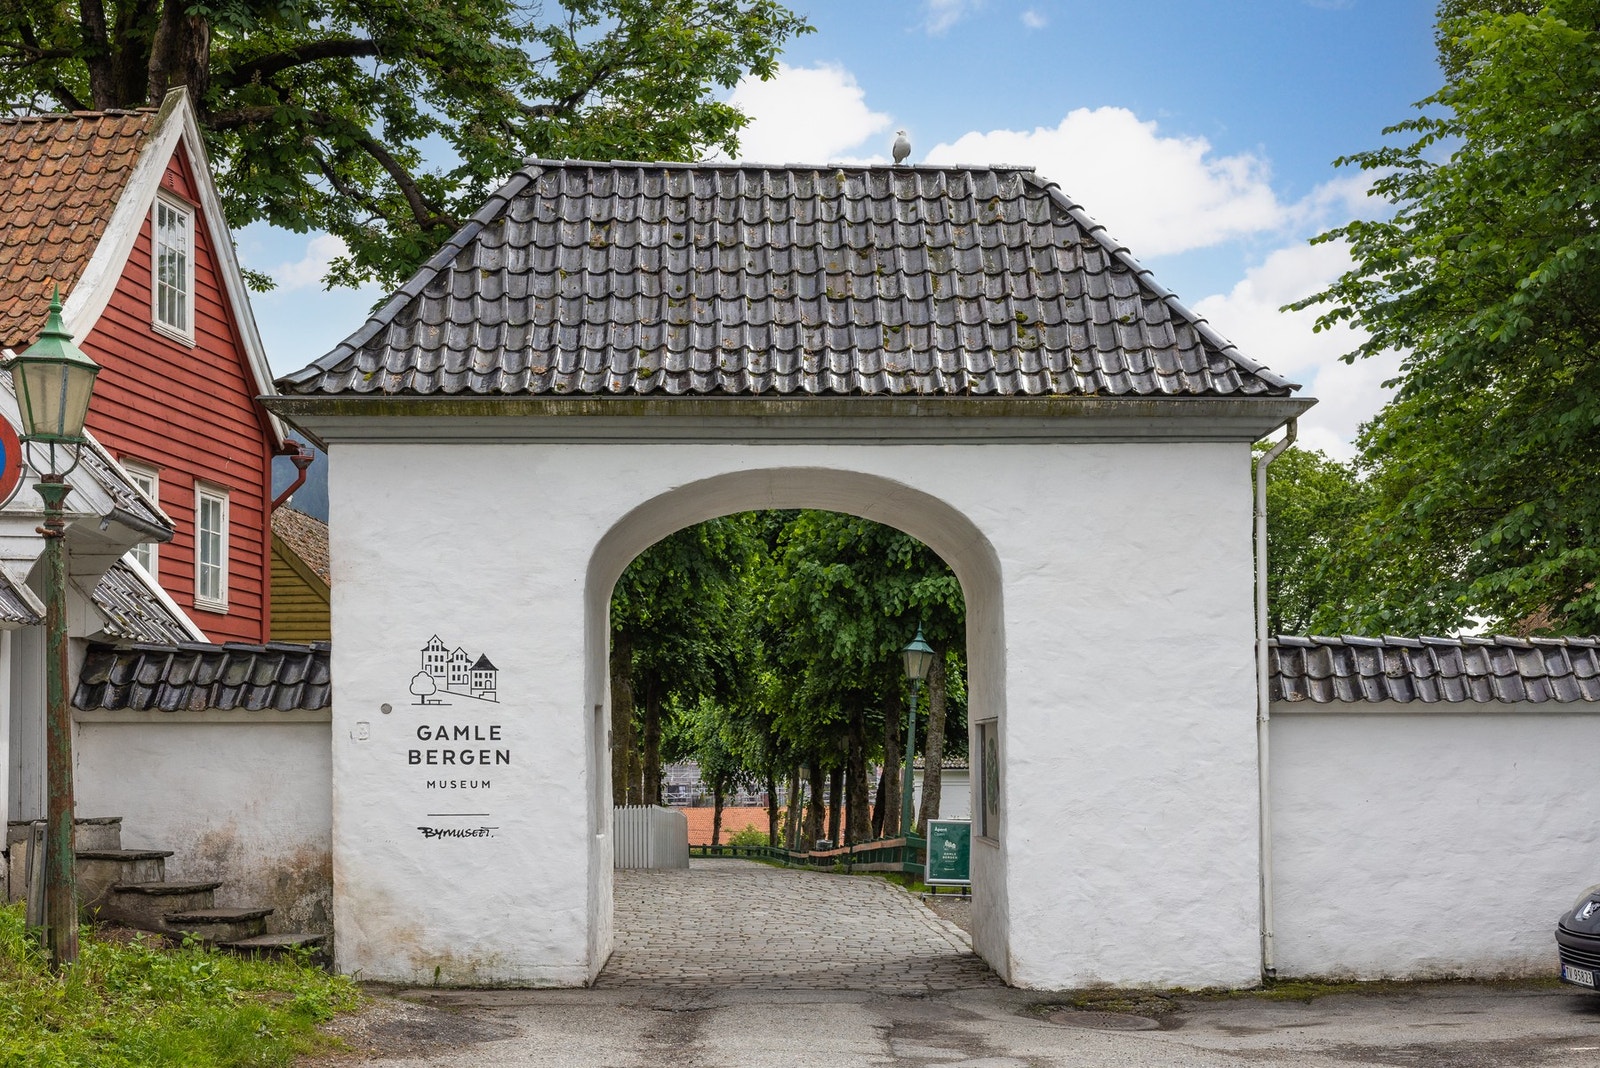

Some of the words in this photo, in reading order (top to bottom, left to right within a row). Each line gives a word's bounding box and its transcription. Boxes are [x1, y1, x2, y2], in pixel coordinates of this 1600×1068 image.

[416, 724, 502, 741] GAMLE
[408, 749, 510, 765] BERGEN
[426, 780, 491, 789] MUSEUM
